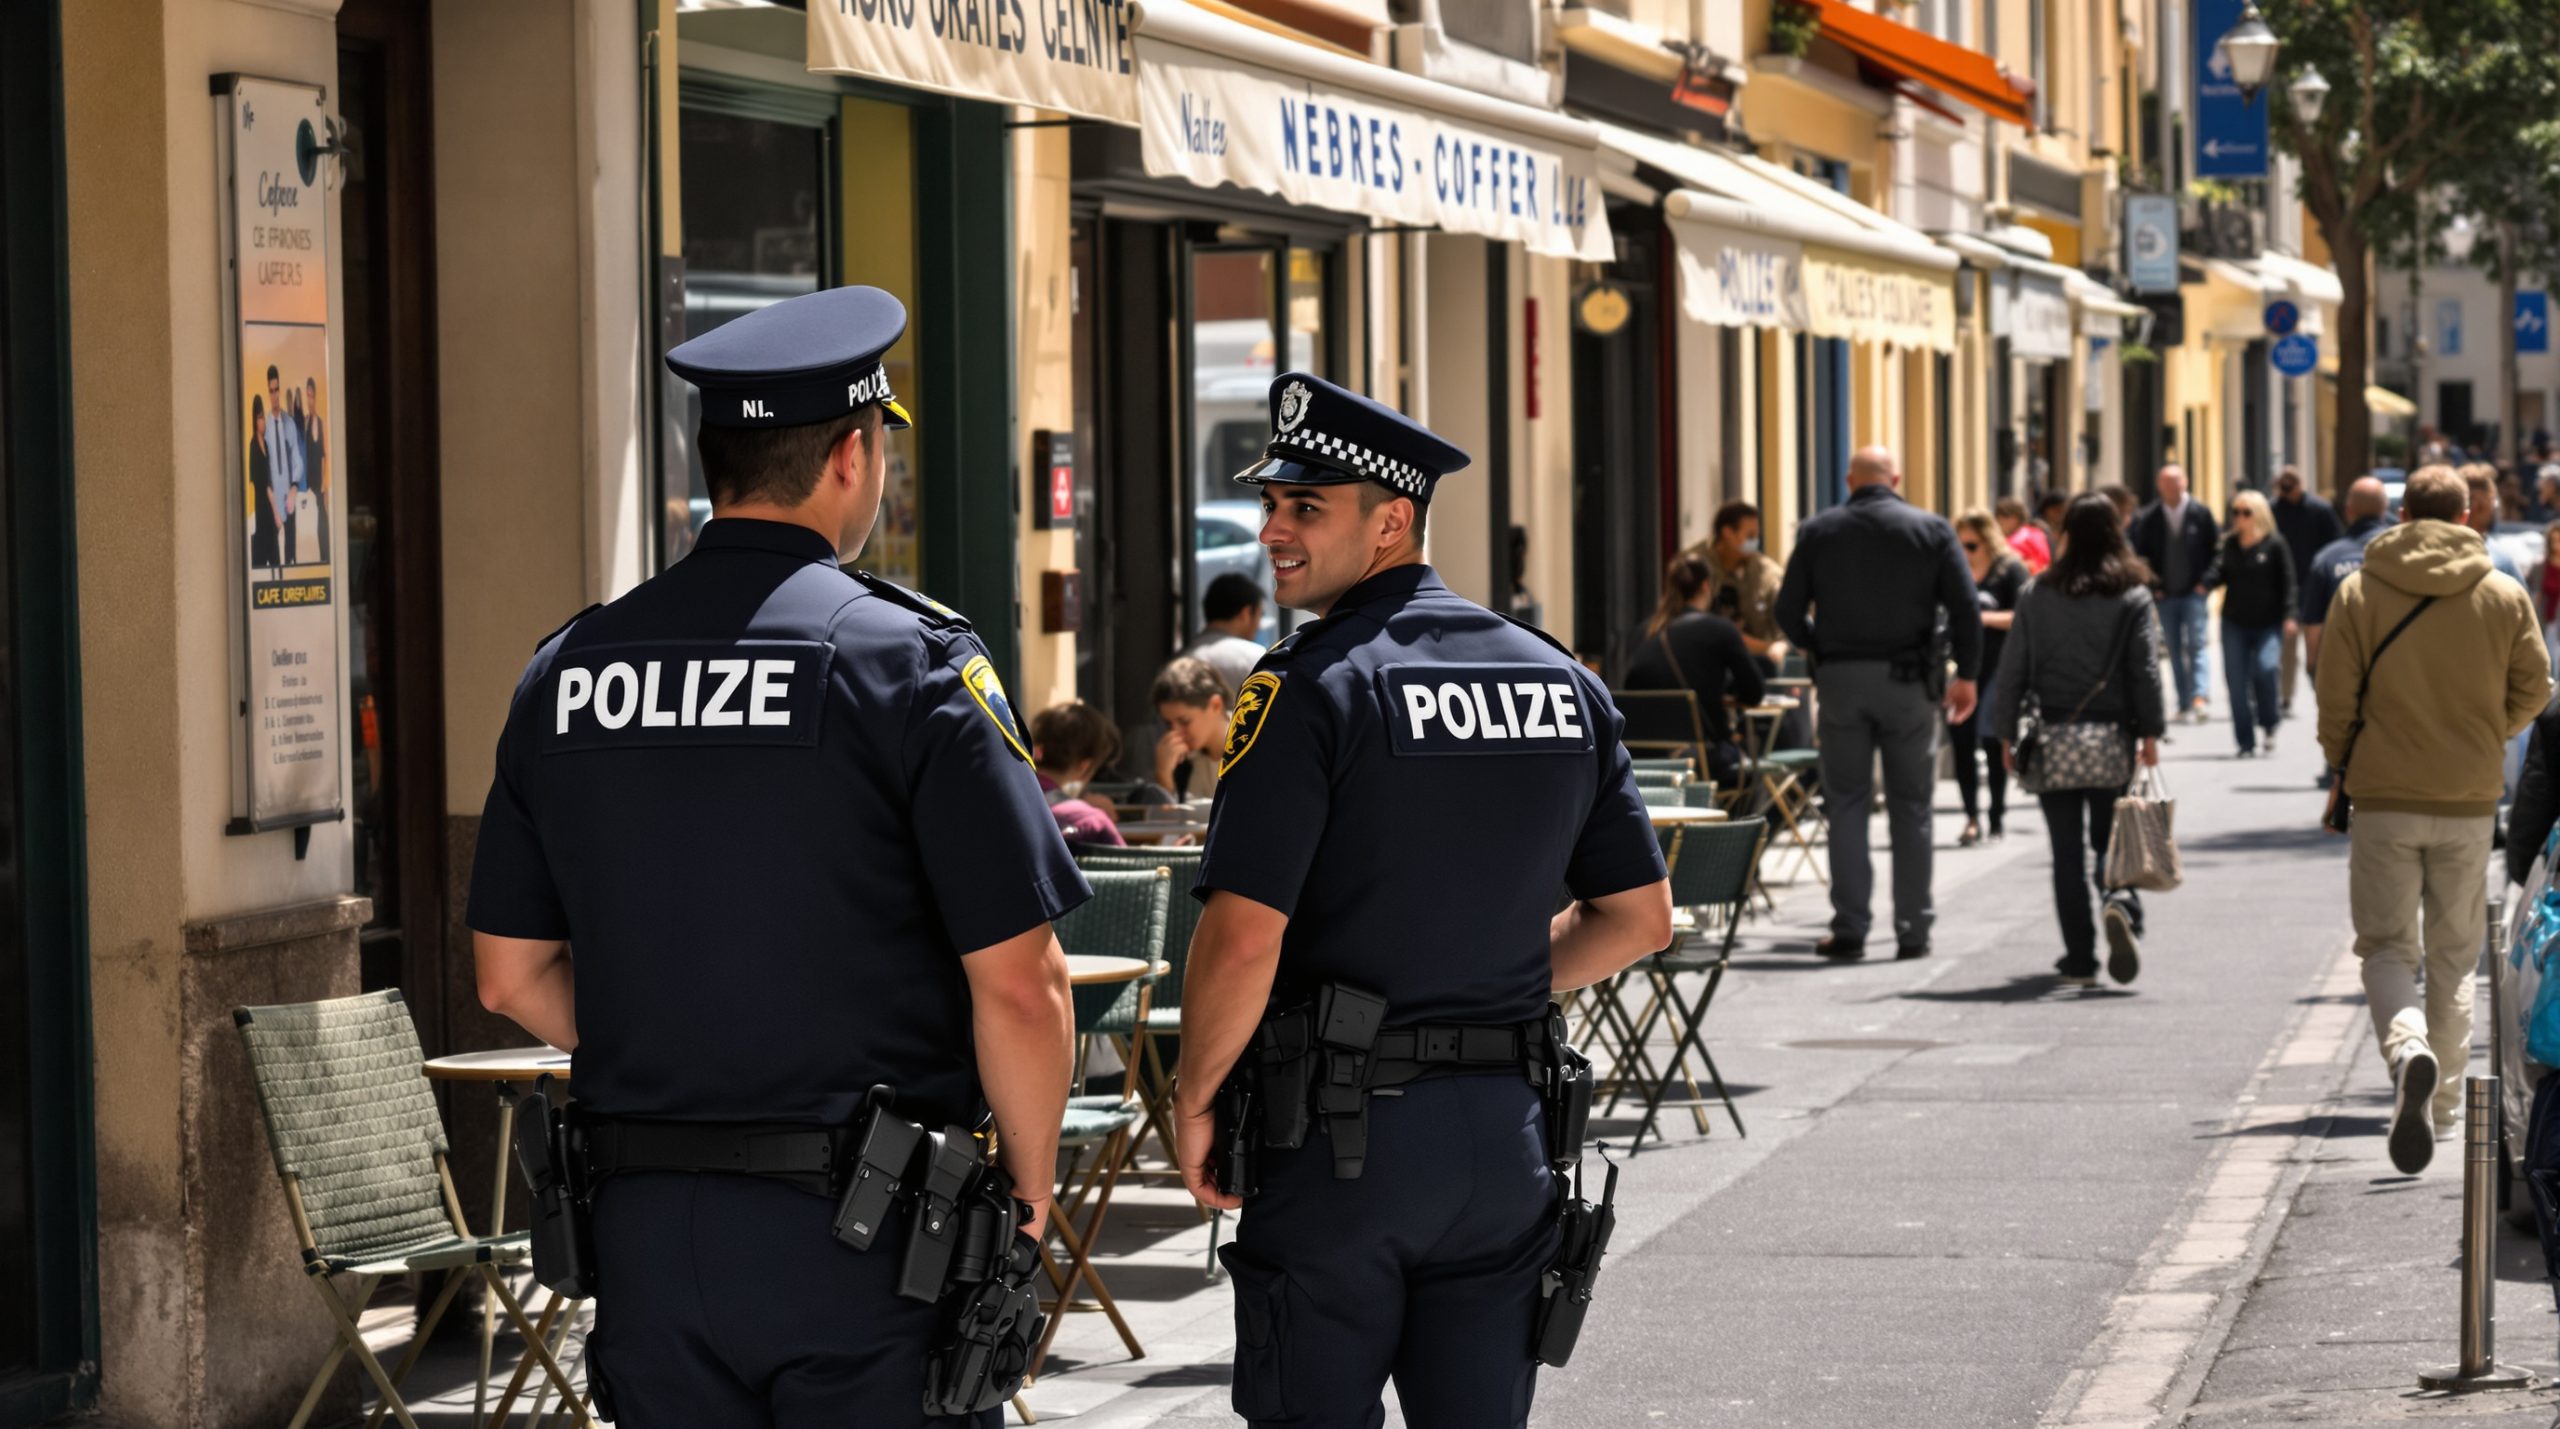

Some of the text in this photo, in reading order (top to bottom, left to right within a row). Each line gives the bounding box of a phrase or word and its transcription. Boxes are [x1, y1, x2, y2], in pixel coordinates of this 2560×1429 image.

[1280, 97, 1403, 193] NEBRES
[1435, 133, 1538, 221] COFFER
[556, 659, 797, 736] POLIZE
[1401, 681, 1584, 740] POLIZE
